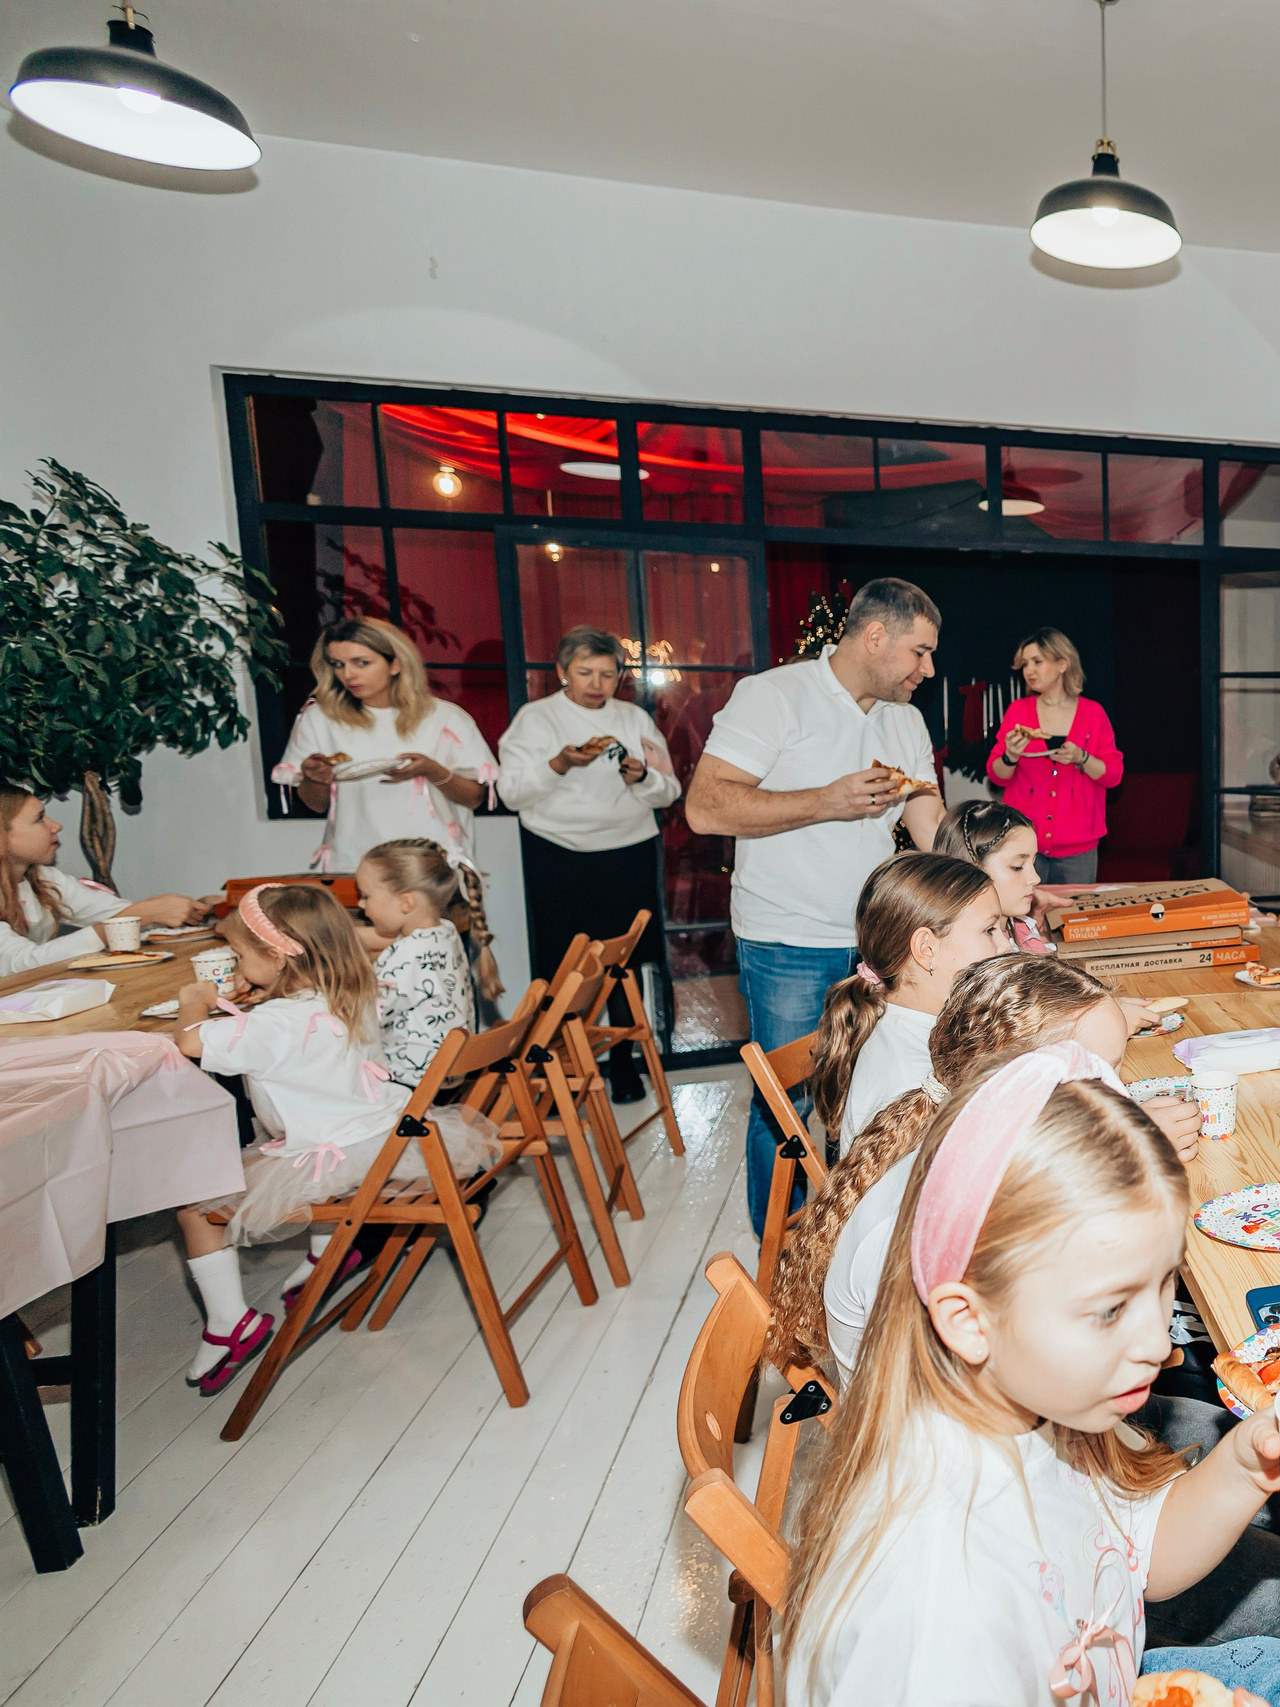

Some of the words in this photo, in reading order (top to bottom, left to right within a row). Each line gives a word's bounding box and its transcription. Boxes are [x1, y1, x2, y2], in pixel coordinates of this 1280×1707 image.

[1068, 924, 1108, 934] ГОРЯЧАЯ
[1068, 930, 1100, 940] ПИЦЦА
[1090, 961, 1140, 971] БЕСПЛАТНАЯ
[1143, 958, 1183, 967] ДОСТАВКА
[1199, 953, 1212, 963] 24
[1216, 950, 1247, 961] ЧАСА
[1251, 1203, 1270, 1213] С
